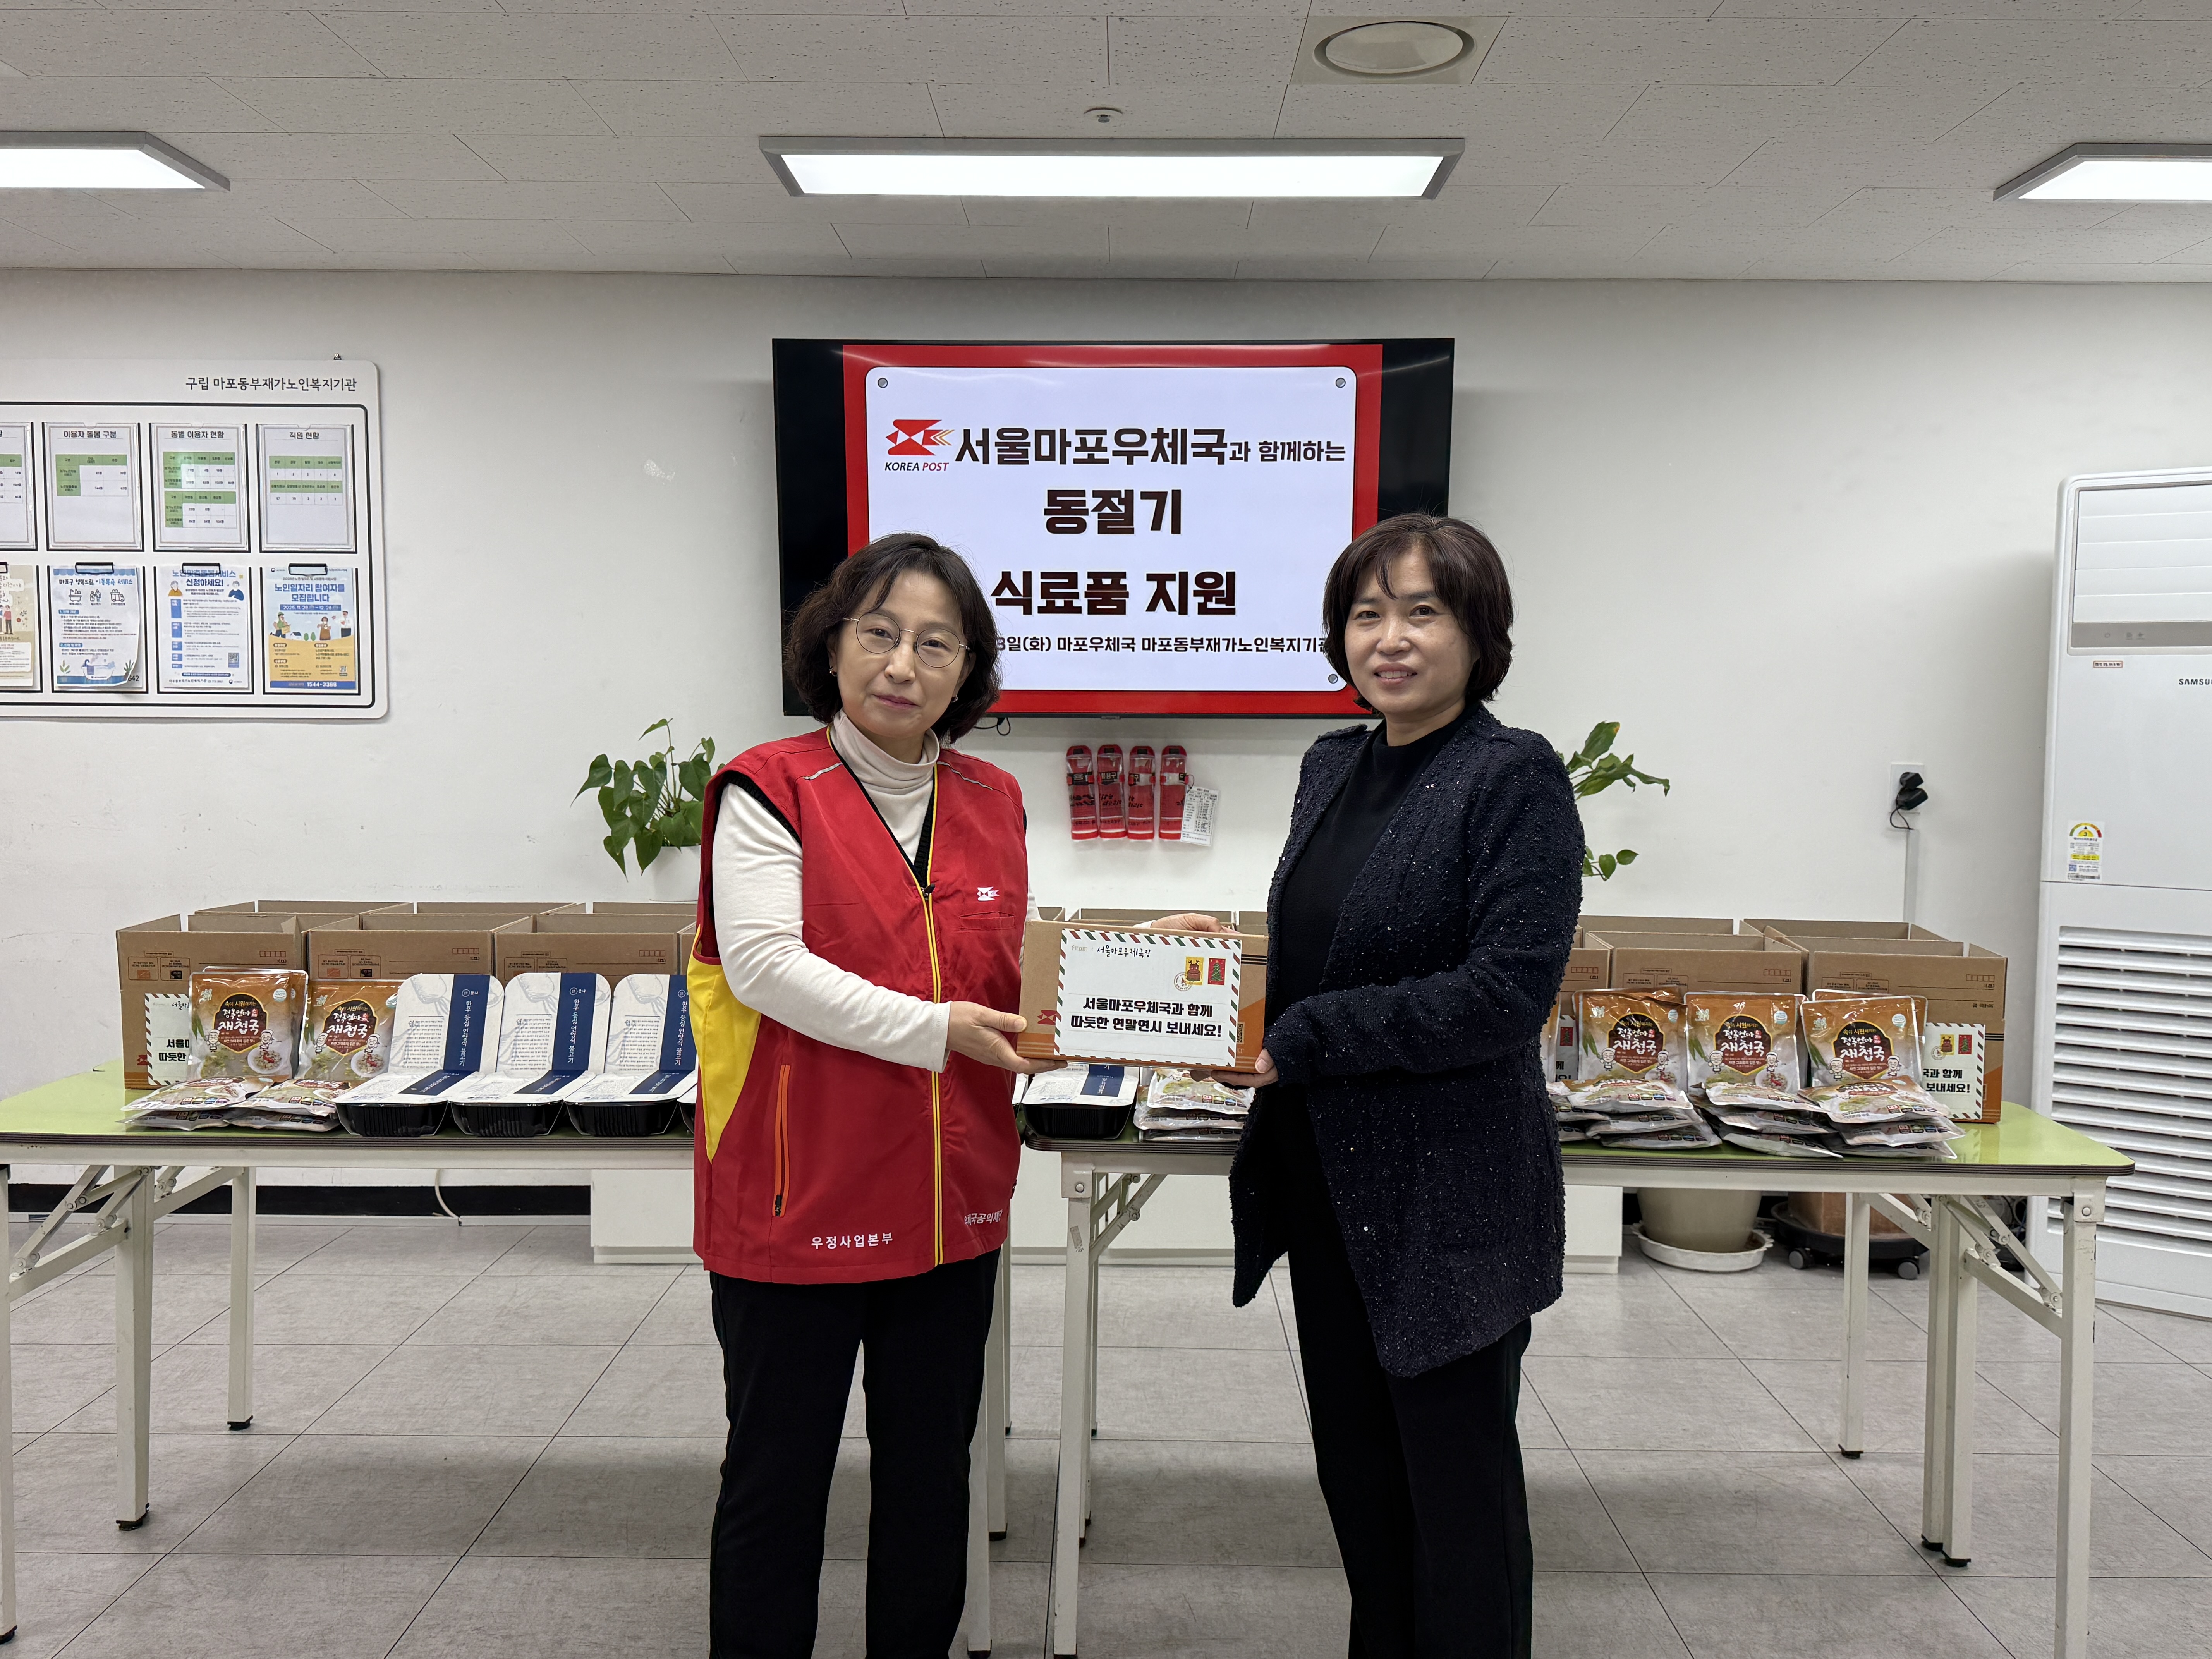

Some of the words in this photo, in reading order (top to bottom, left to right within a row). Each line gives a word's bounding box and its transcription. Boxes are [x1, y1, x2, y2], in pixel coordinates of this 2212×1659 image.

[186, 377, 208, 390] 구립
[213, 377, 357, 391] 마포동부재가노인복지기관
[955, 428, 1251, 465] 서울마포우체국과
[1259, 441, 1346, 462] 함께하는
[885, 462, 919, 471] KOREA
[922, 462, 949, 471] POST
[1043, 489, 1182, 535] 동절기
[275, 583, 313, 592] 노인일자리
[990, 571, 1129, 616] 식료품
[1145, 571, 1237, 616] 지원
[292, 594, 330, 602] 모집합니다
[1057, 636, 1136, 652] 마포우체국
[465, 1001, 472, 1012] 한우
[573, 999, 580, 1010] 한우
[681, 1001, 687, 1013] 한우
[1082, 997, 1184, 1016] 서울마포우체국과
[1187, 1003, 1212, 1017] 함께
[464, 1014, 471, 1027] 등심
[571, 1012, 578, 1025] 등심
[680, 1014, 686, 1027] 등심
[217, 1018, 259, 1035] 재첩국
[326, 1022, 368, 1038] 재첩국
[1071, 1015, 1109, 1030] 따듯한
[1112, 1017, 1162, 1034] 연말연시
[1166, 1021, 1221, 1037] 보내세요!
[1613, 1038, 1656, 1056] 재첩국
[1720, 1039, 1764, 1057] 재첩국
[1840, 1045, 1885, 1062] 재첩국
[158, 1052, 186, 1061] 따듯한
[1942, 1069, 1963, 1079] 함께
[1926, 1083, 1970, 1093] 보내세요!
[811, 1232, 893, 1250] 우정사업본부
